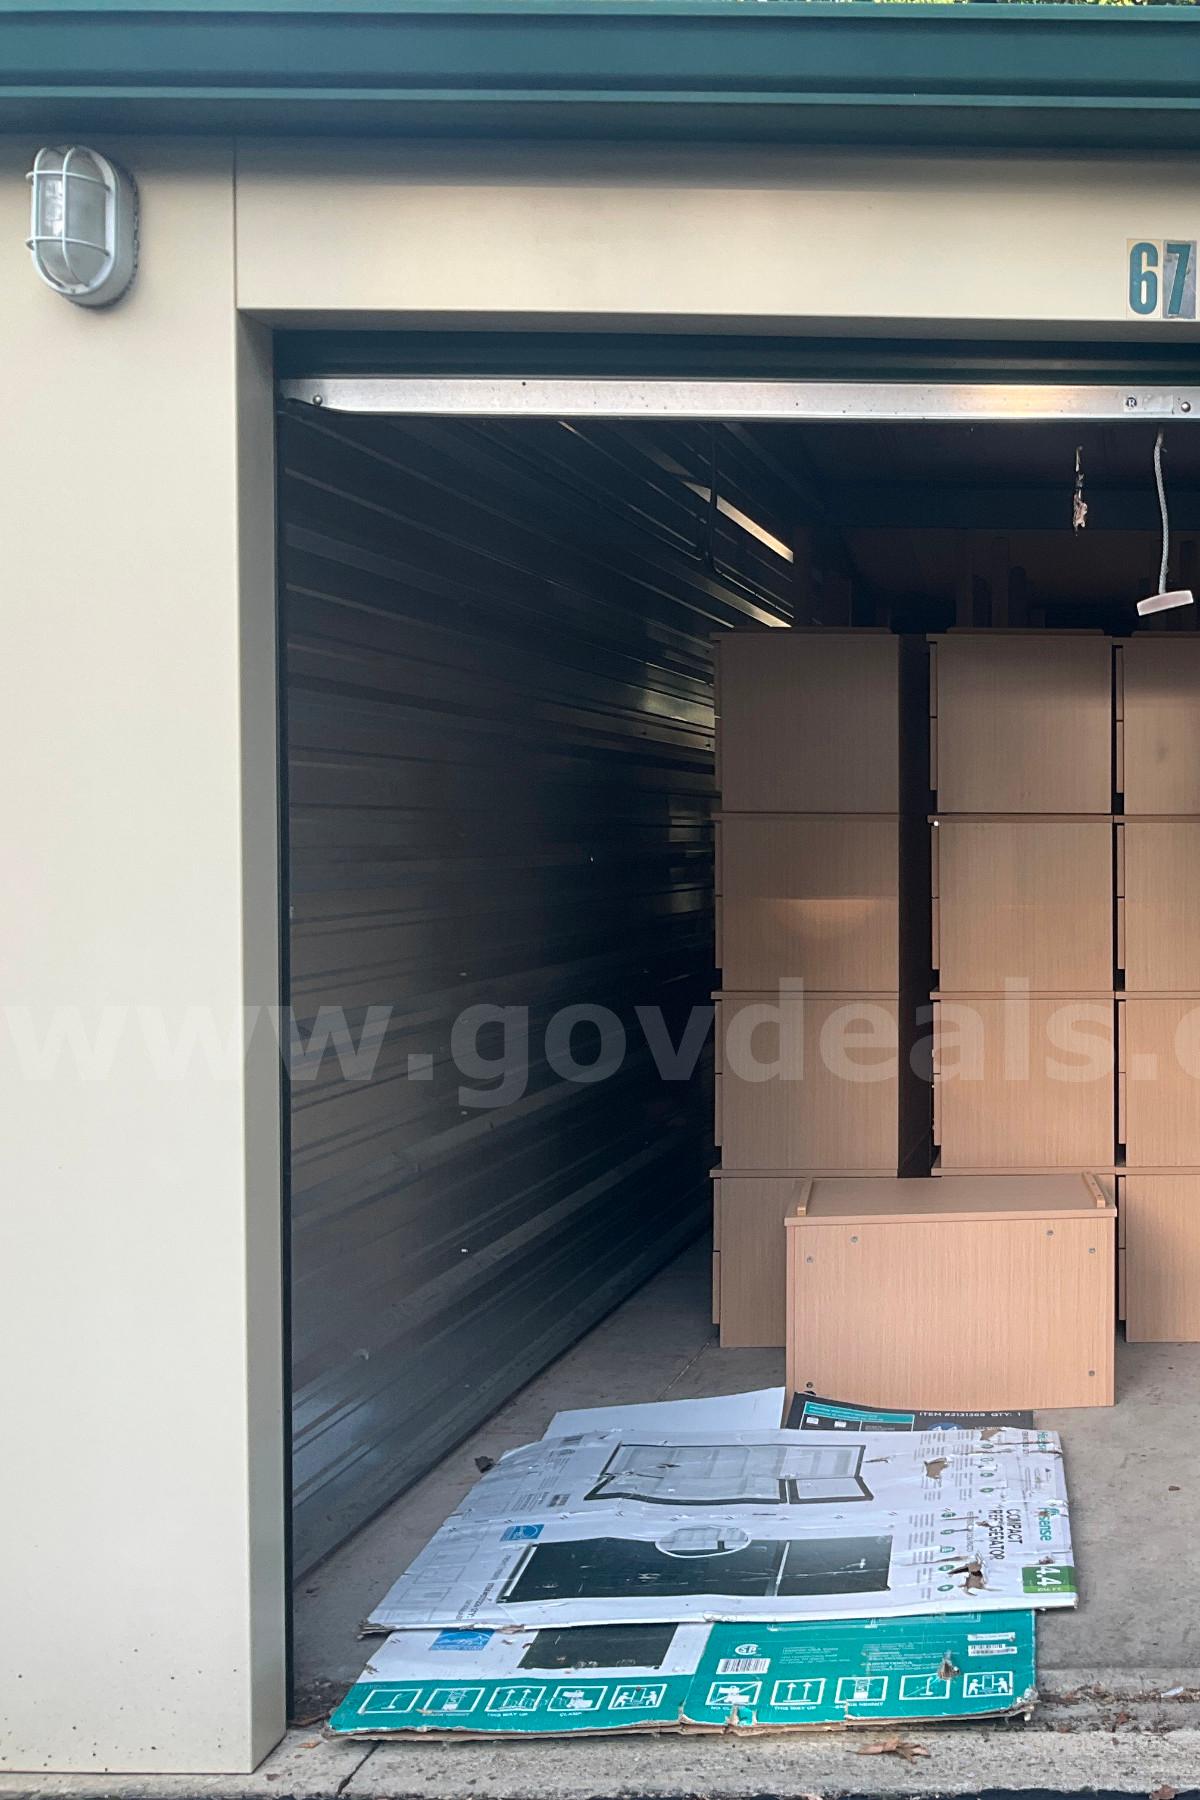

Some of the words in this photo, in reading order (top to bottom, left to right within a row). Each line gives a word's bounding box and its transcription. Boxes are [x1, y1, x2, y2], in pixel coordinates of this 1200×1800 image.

[1128, 241, 1192, 315] 67
[988, 1509, 1005, 1560] REFGERATOR
[1006, 1508, 1023, 1544] COMPACT
[1035, 1566, 1062, 1586] 4.4
